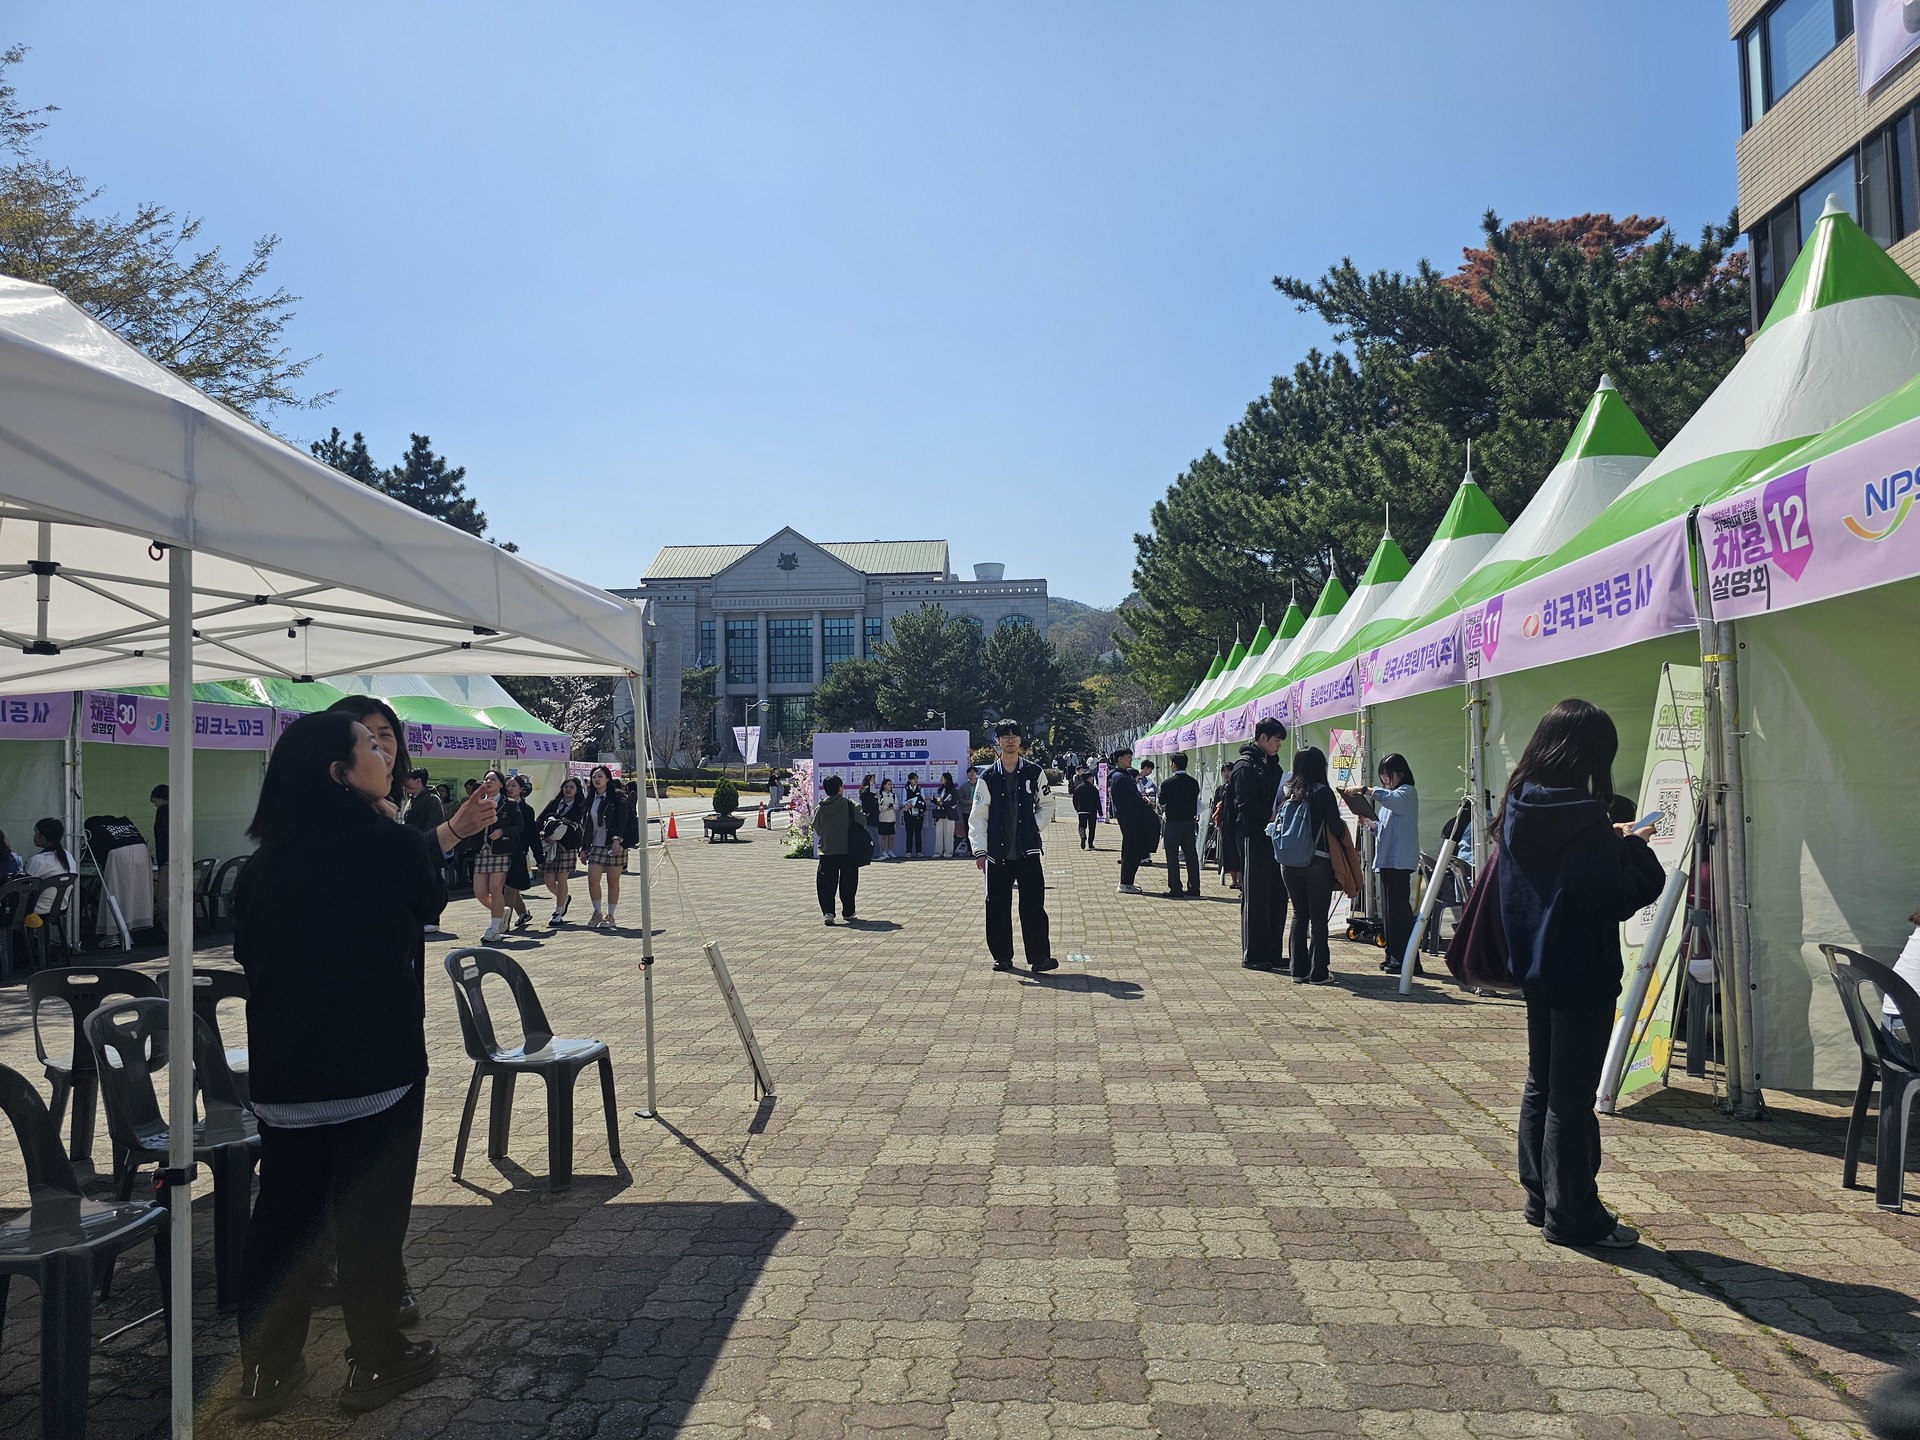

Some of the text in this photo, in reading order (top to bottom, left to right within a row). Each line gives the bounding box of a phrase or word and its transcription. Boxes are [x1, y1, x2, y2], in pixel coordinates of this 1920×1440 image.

[1742, 507, 1758, 523] 합동
[1767, 494, 1810, 554] 12
[1711, 521, 1773, 571] 채용
[1712, 563, 1770, 611] 설명회
[1542, 564, 1653, 637] 한국전력공사
[1485, 610, 1500, 645] 11
[1382, 635, 1457, 684] 한국수력원자력(주)
[90, 703, 119, 724] 채용
[118, 703, 136, 725] 30
[91, 721, 116, 743] 설명회
[423, 730, 433, 745] 32
[443, 735, 475, 750] 고용노동부
[883, 737, 928, 749] 채용 설명회
